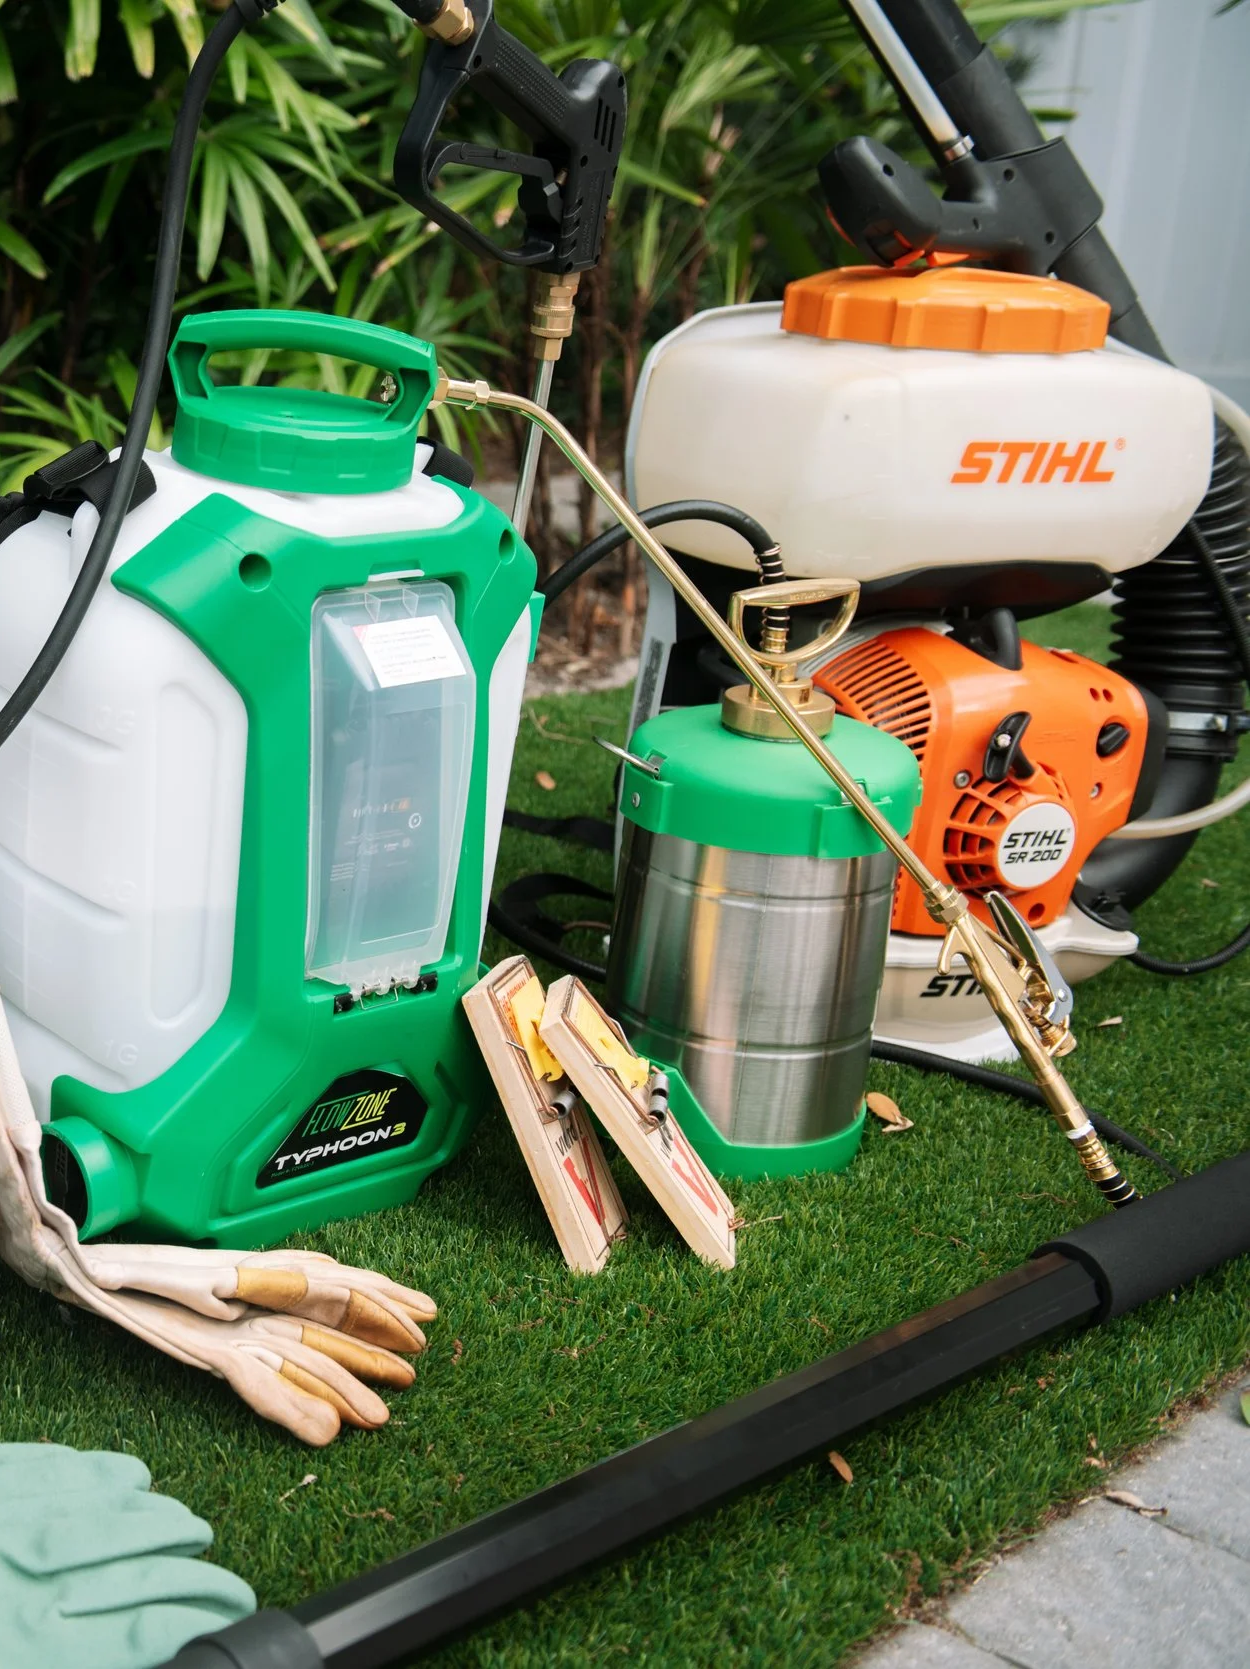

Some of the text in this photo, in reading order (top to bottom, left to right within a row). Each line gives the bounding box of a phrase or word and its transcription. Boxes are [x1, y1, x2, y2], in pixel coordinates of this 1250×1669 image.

[950, 441, 1115, 483] STIHL
[1004, 829, 1068, 849] STIHL
[1005, 849, 1062, 865] SR 200
[919, 974, 984, 998] STI
[104, 1039, 139, 1066] 1G
[302, 1087, 397, 1138] FLOWZONE
